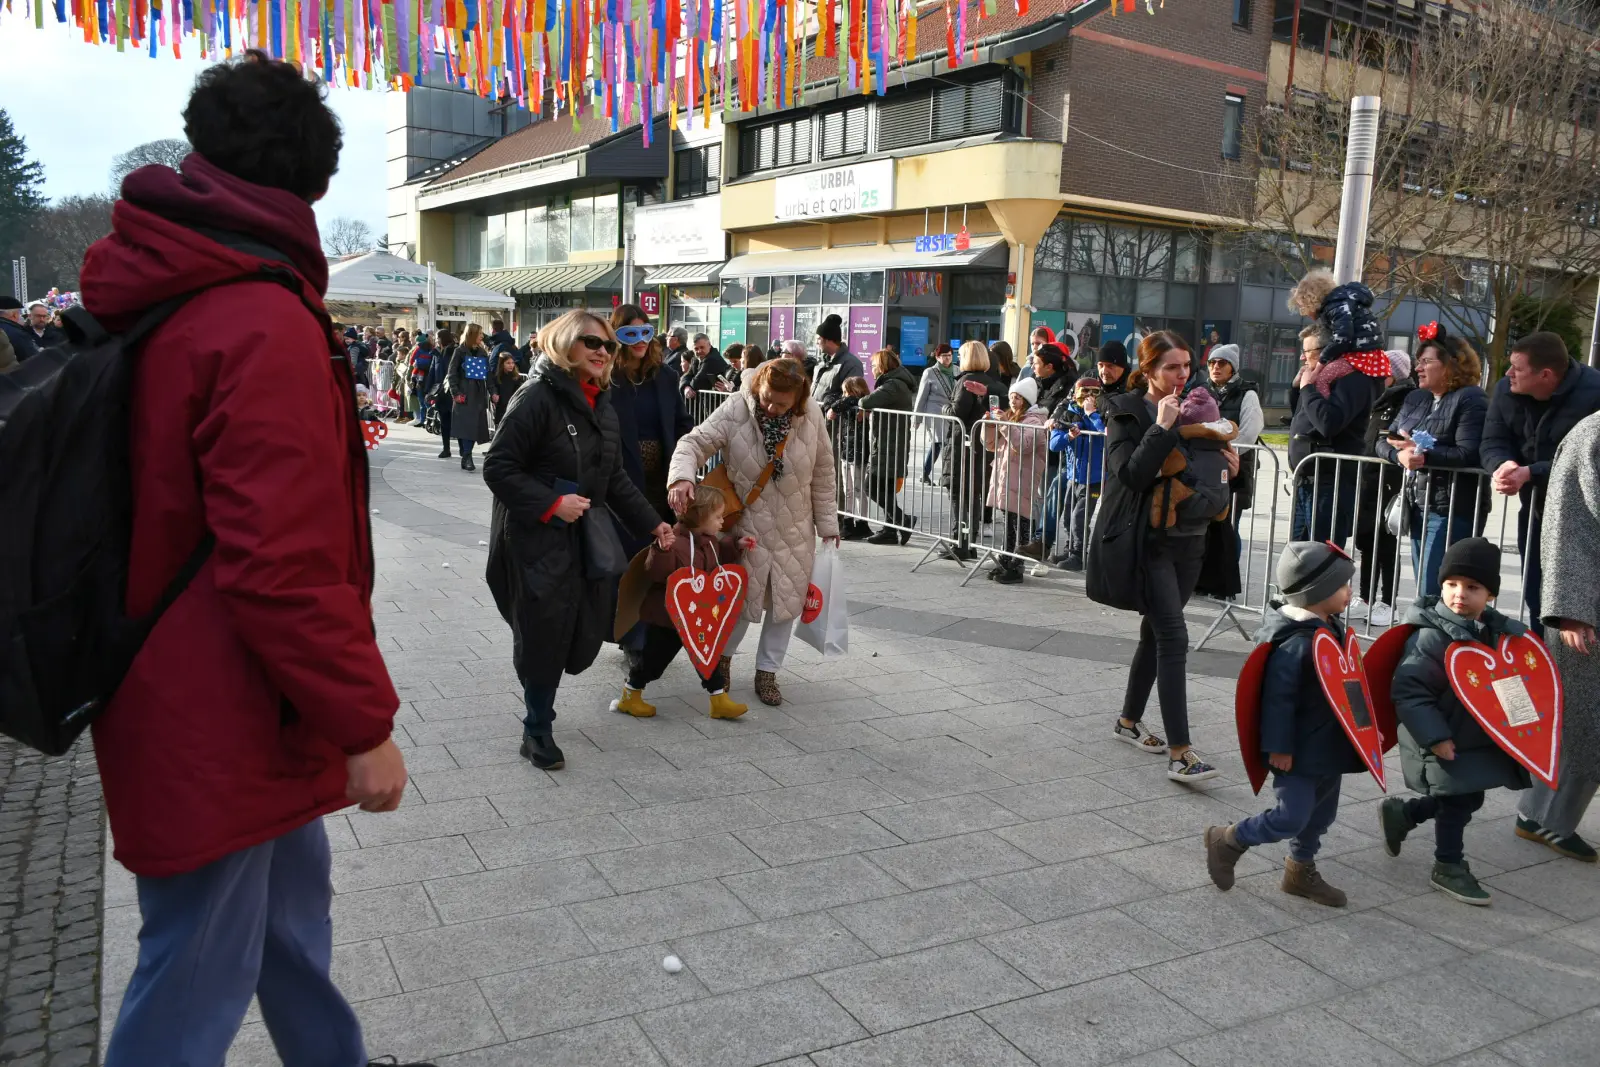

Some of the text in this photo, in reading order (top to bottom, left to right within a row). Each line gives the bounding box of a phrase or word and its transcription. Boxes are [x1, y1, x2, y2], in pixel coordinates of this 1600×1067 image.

[820, 169, 855, 190] URBIA
[785, 189, 879, 217] urbi et orbi 25
[915, 233, 955, 252] ERSTE
[645, 296, 656, 311] T
